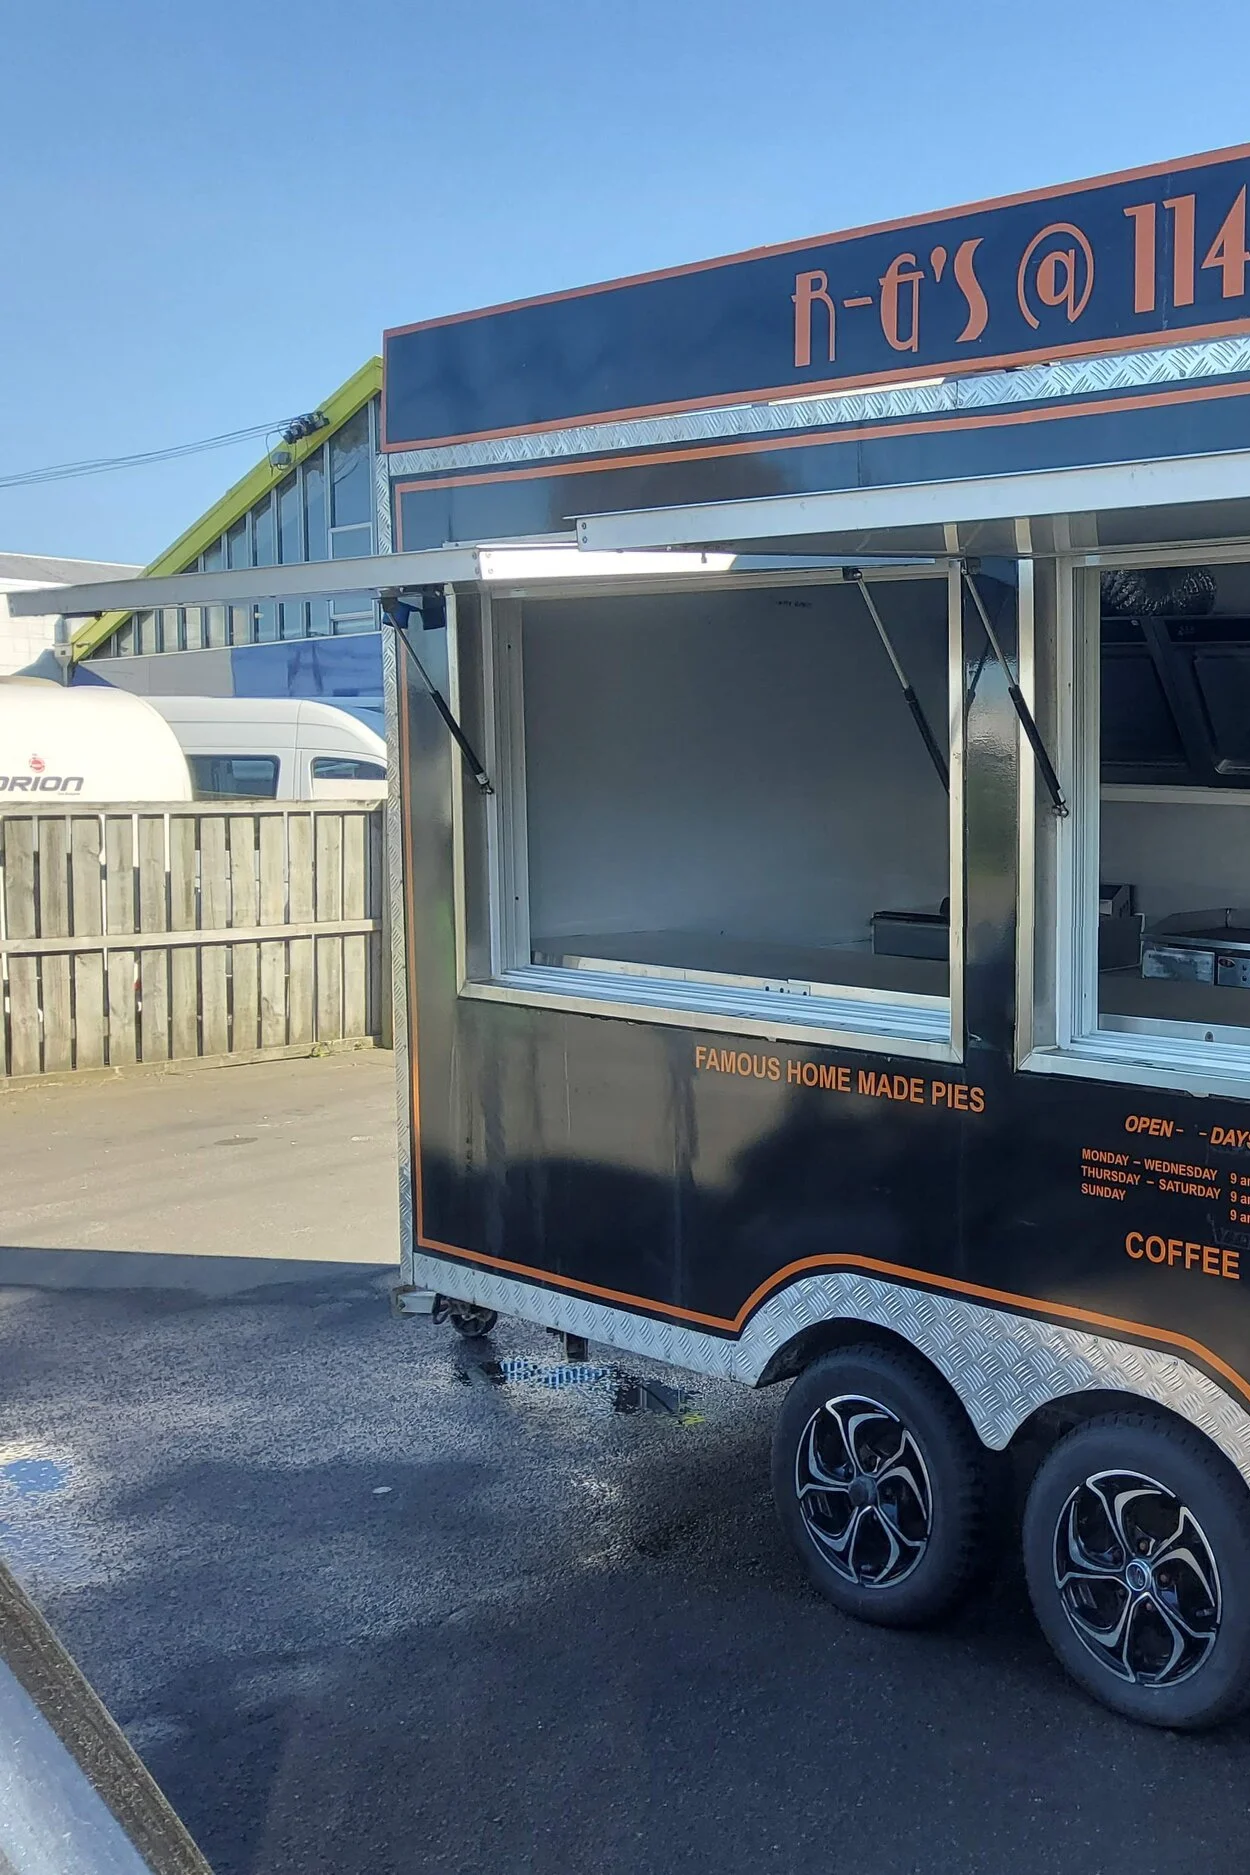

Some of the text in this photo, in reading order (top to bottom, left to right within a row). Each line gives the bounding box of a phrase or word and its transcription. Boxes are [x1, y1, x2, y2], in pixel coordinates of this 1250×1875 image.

[1017, 222, 1095, 330] @
[695, 1045, 985, 1113] FAMOUS HOME MADE PIES
[1081, 1165, 1141, 1186] THURSDAY
[1158, 1178, 1222, 1200] SATURDAY
[1230, 1190, 1237, 1202] 9
[1082, 1148, 1130, 1166] MONDAY
[1144, 1158, 1218, 1181] WEDNESDAY
[1230, 1172, 1237, 1184] 9
[1081, 1182, 1126, 1201] SUNDAY
[1230, 1209, 1237, 1221] 9
[1125, 1231, 1241, 1280] COFFEE
